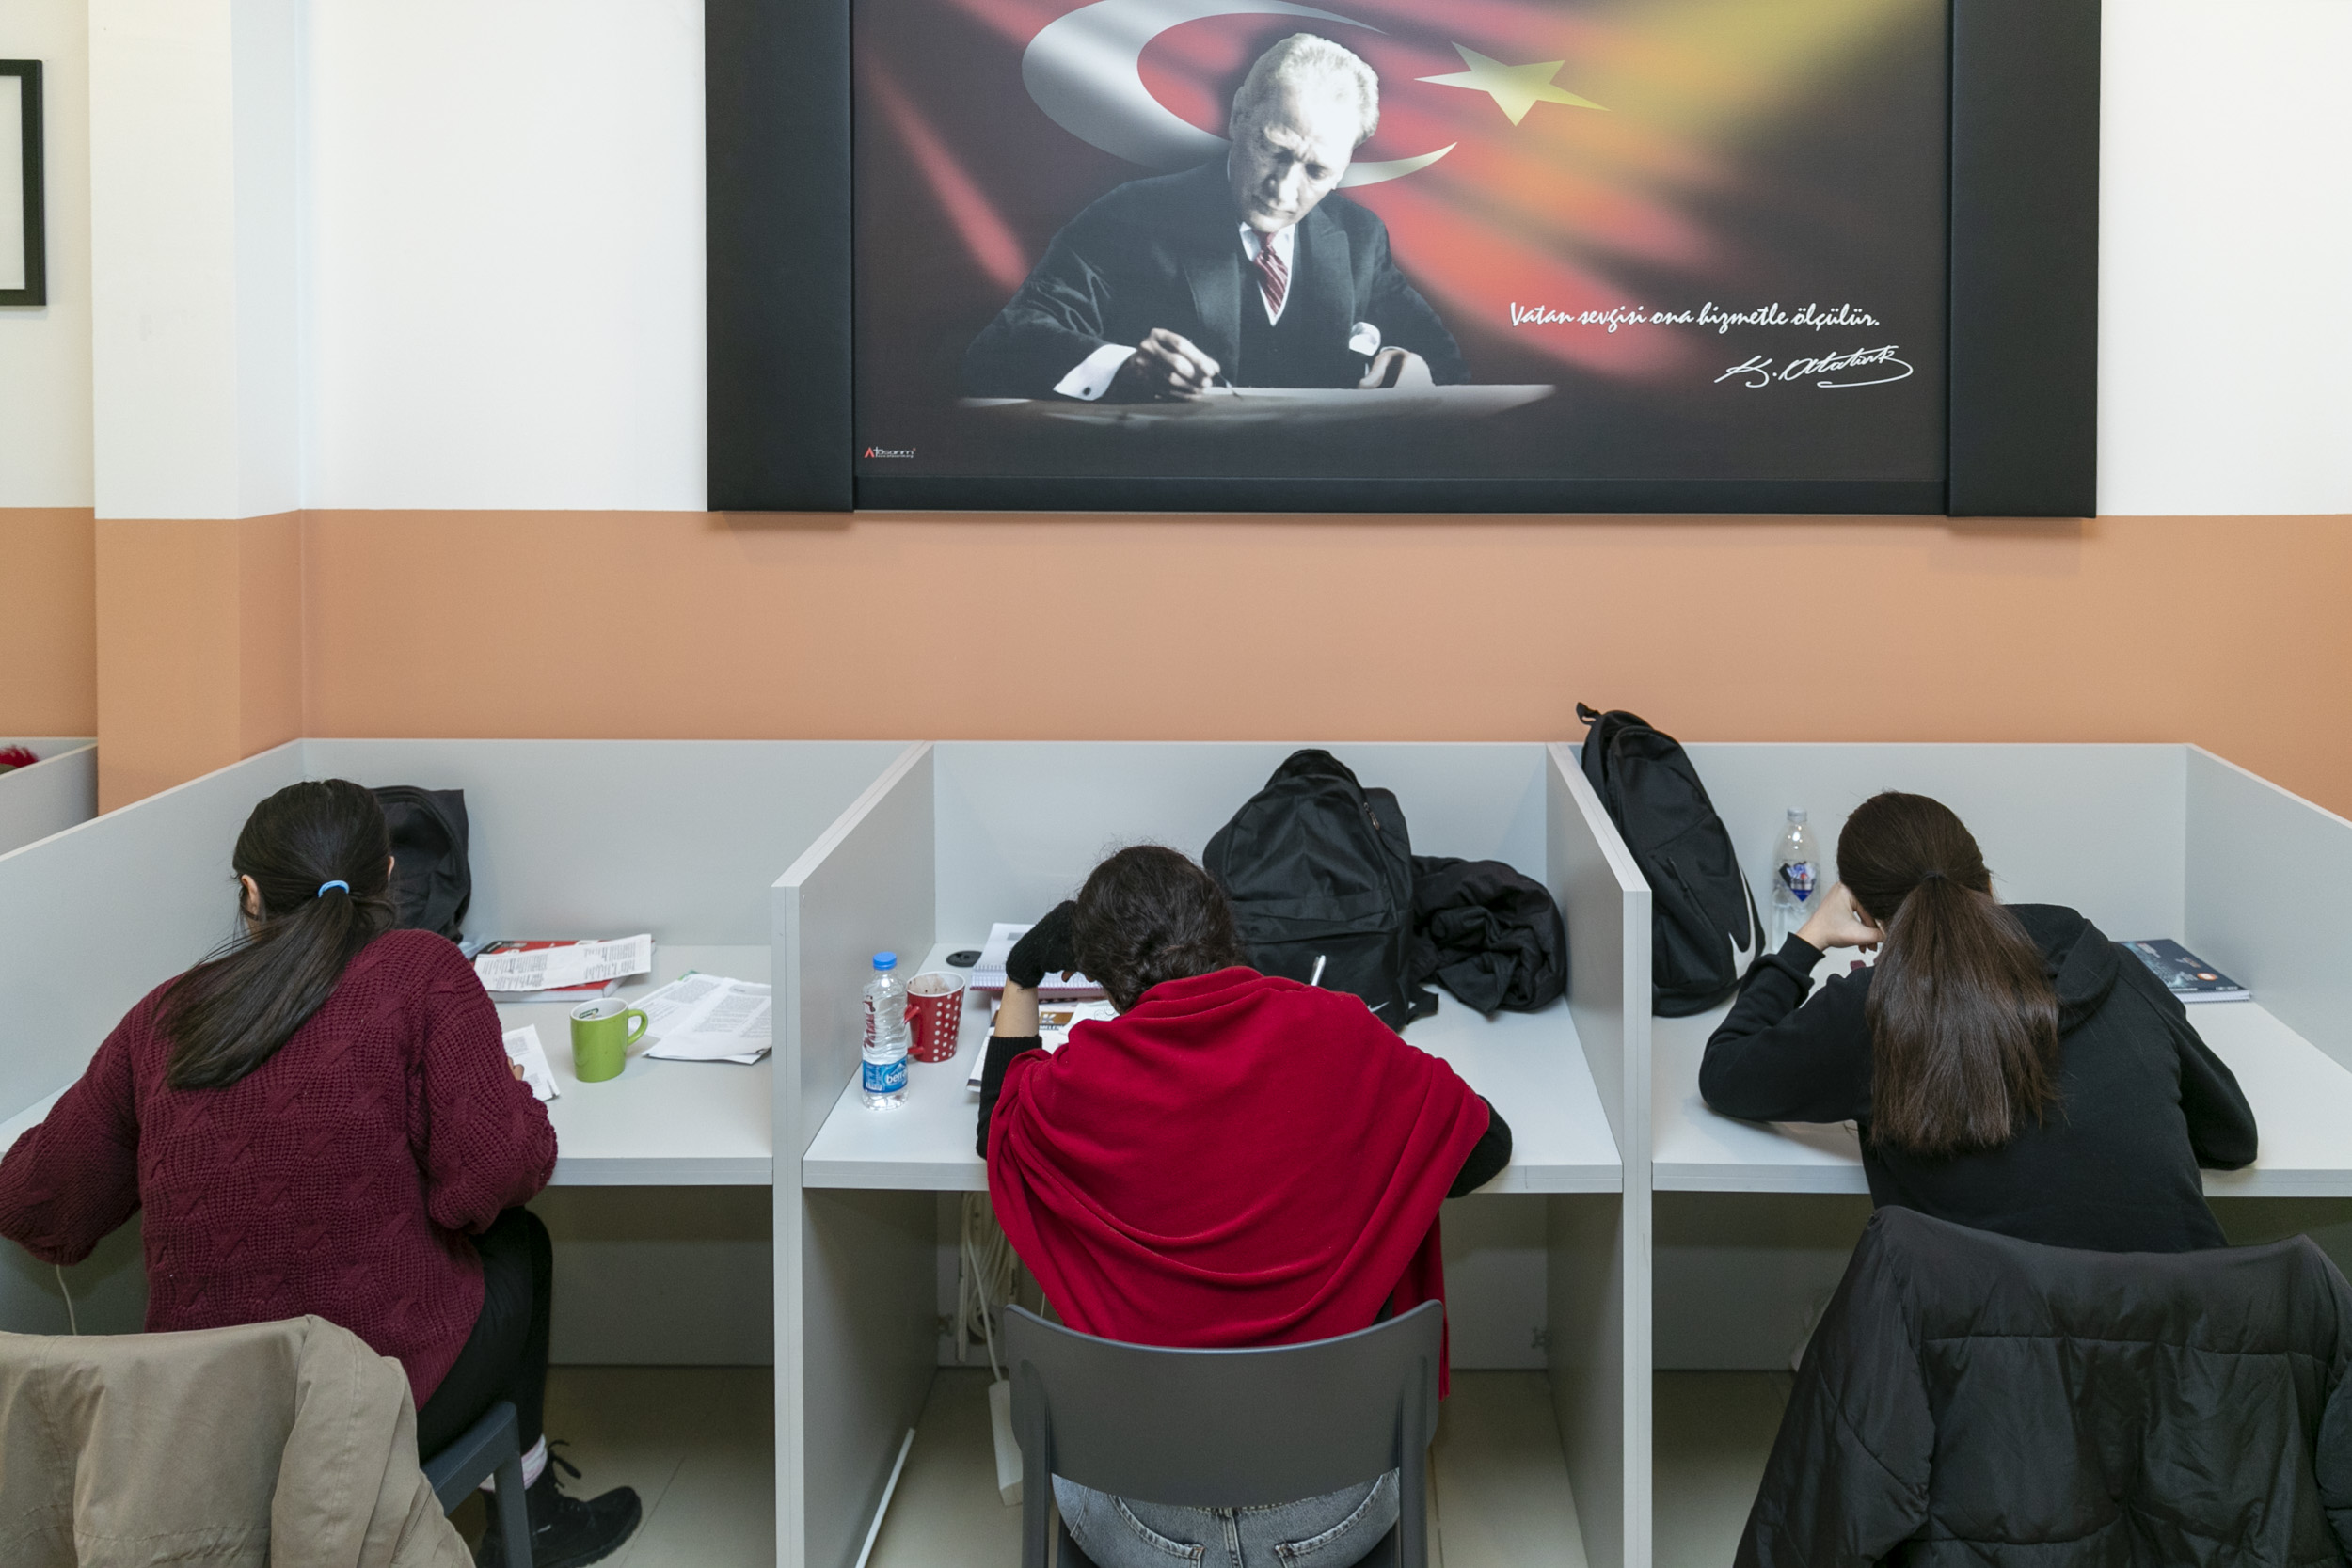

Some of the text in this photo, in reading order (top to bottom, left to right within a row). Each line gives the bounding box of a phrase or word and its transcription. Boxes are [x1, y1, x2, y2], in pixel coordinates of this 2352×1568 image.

[1510, 301, 1881, 334] Vatan sevgisi ona hizmetle ölçülür.
